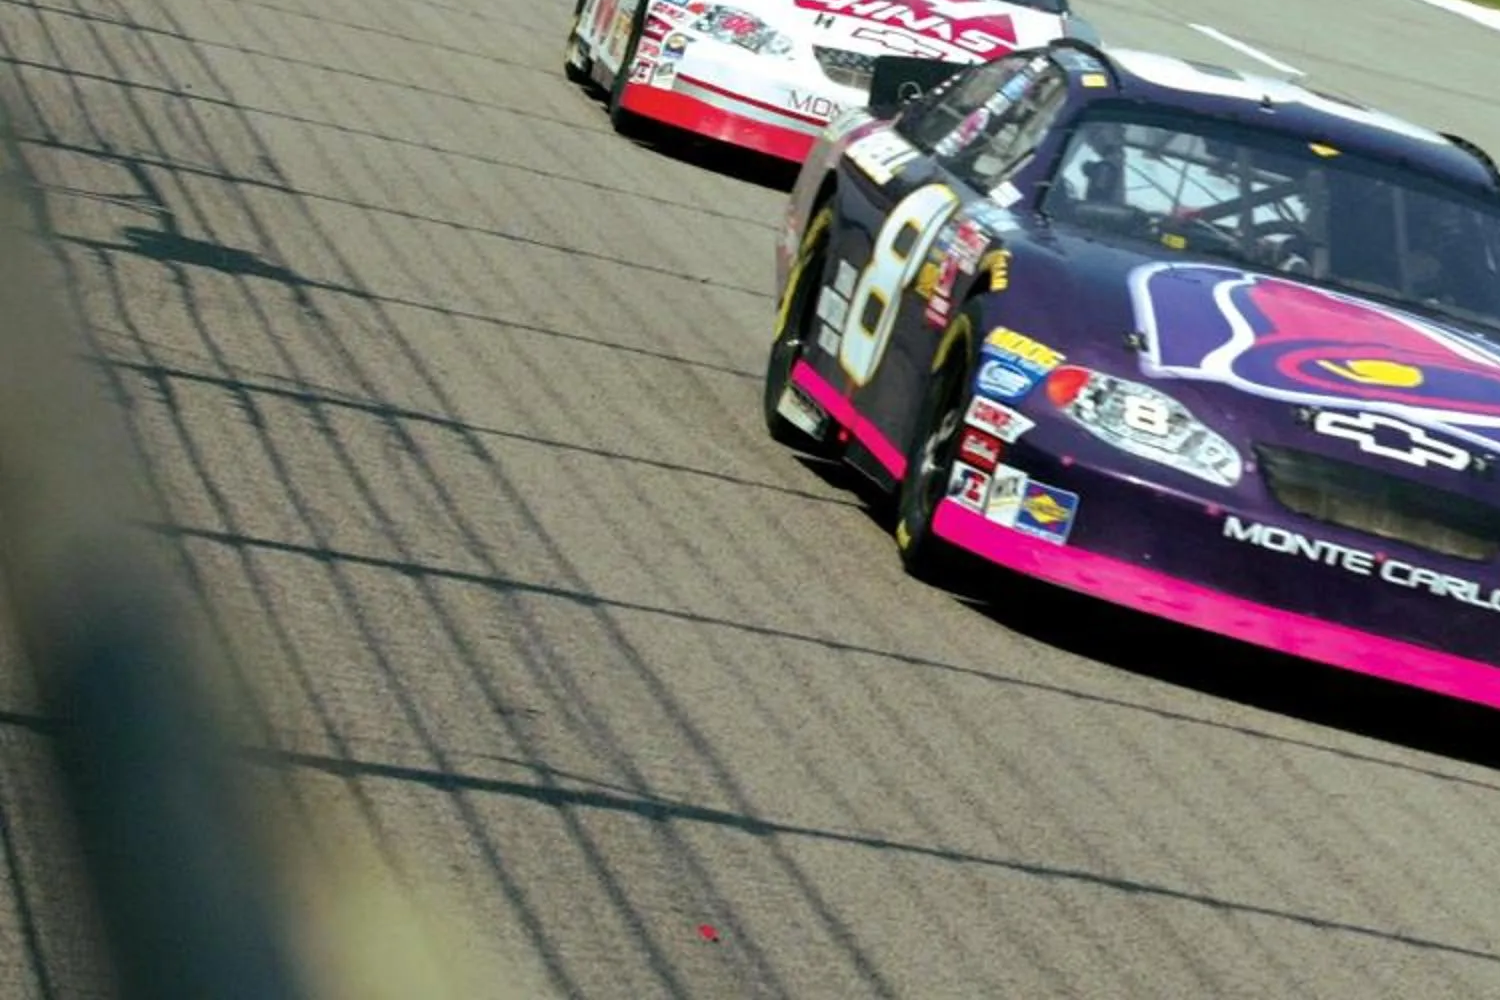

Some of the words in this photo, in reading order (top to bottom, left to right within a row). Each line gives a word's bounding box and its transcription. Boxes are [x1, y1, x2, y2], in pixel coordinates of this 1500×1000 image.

[837, 181, 960, 388] 8
[1123, 396, 1171, 435] 8
[1222, 515, 1375, 577] MONTE
